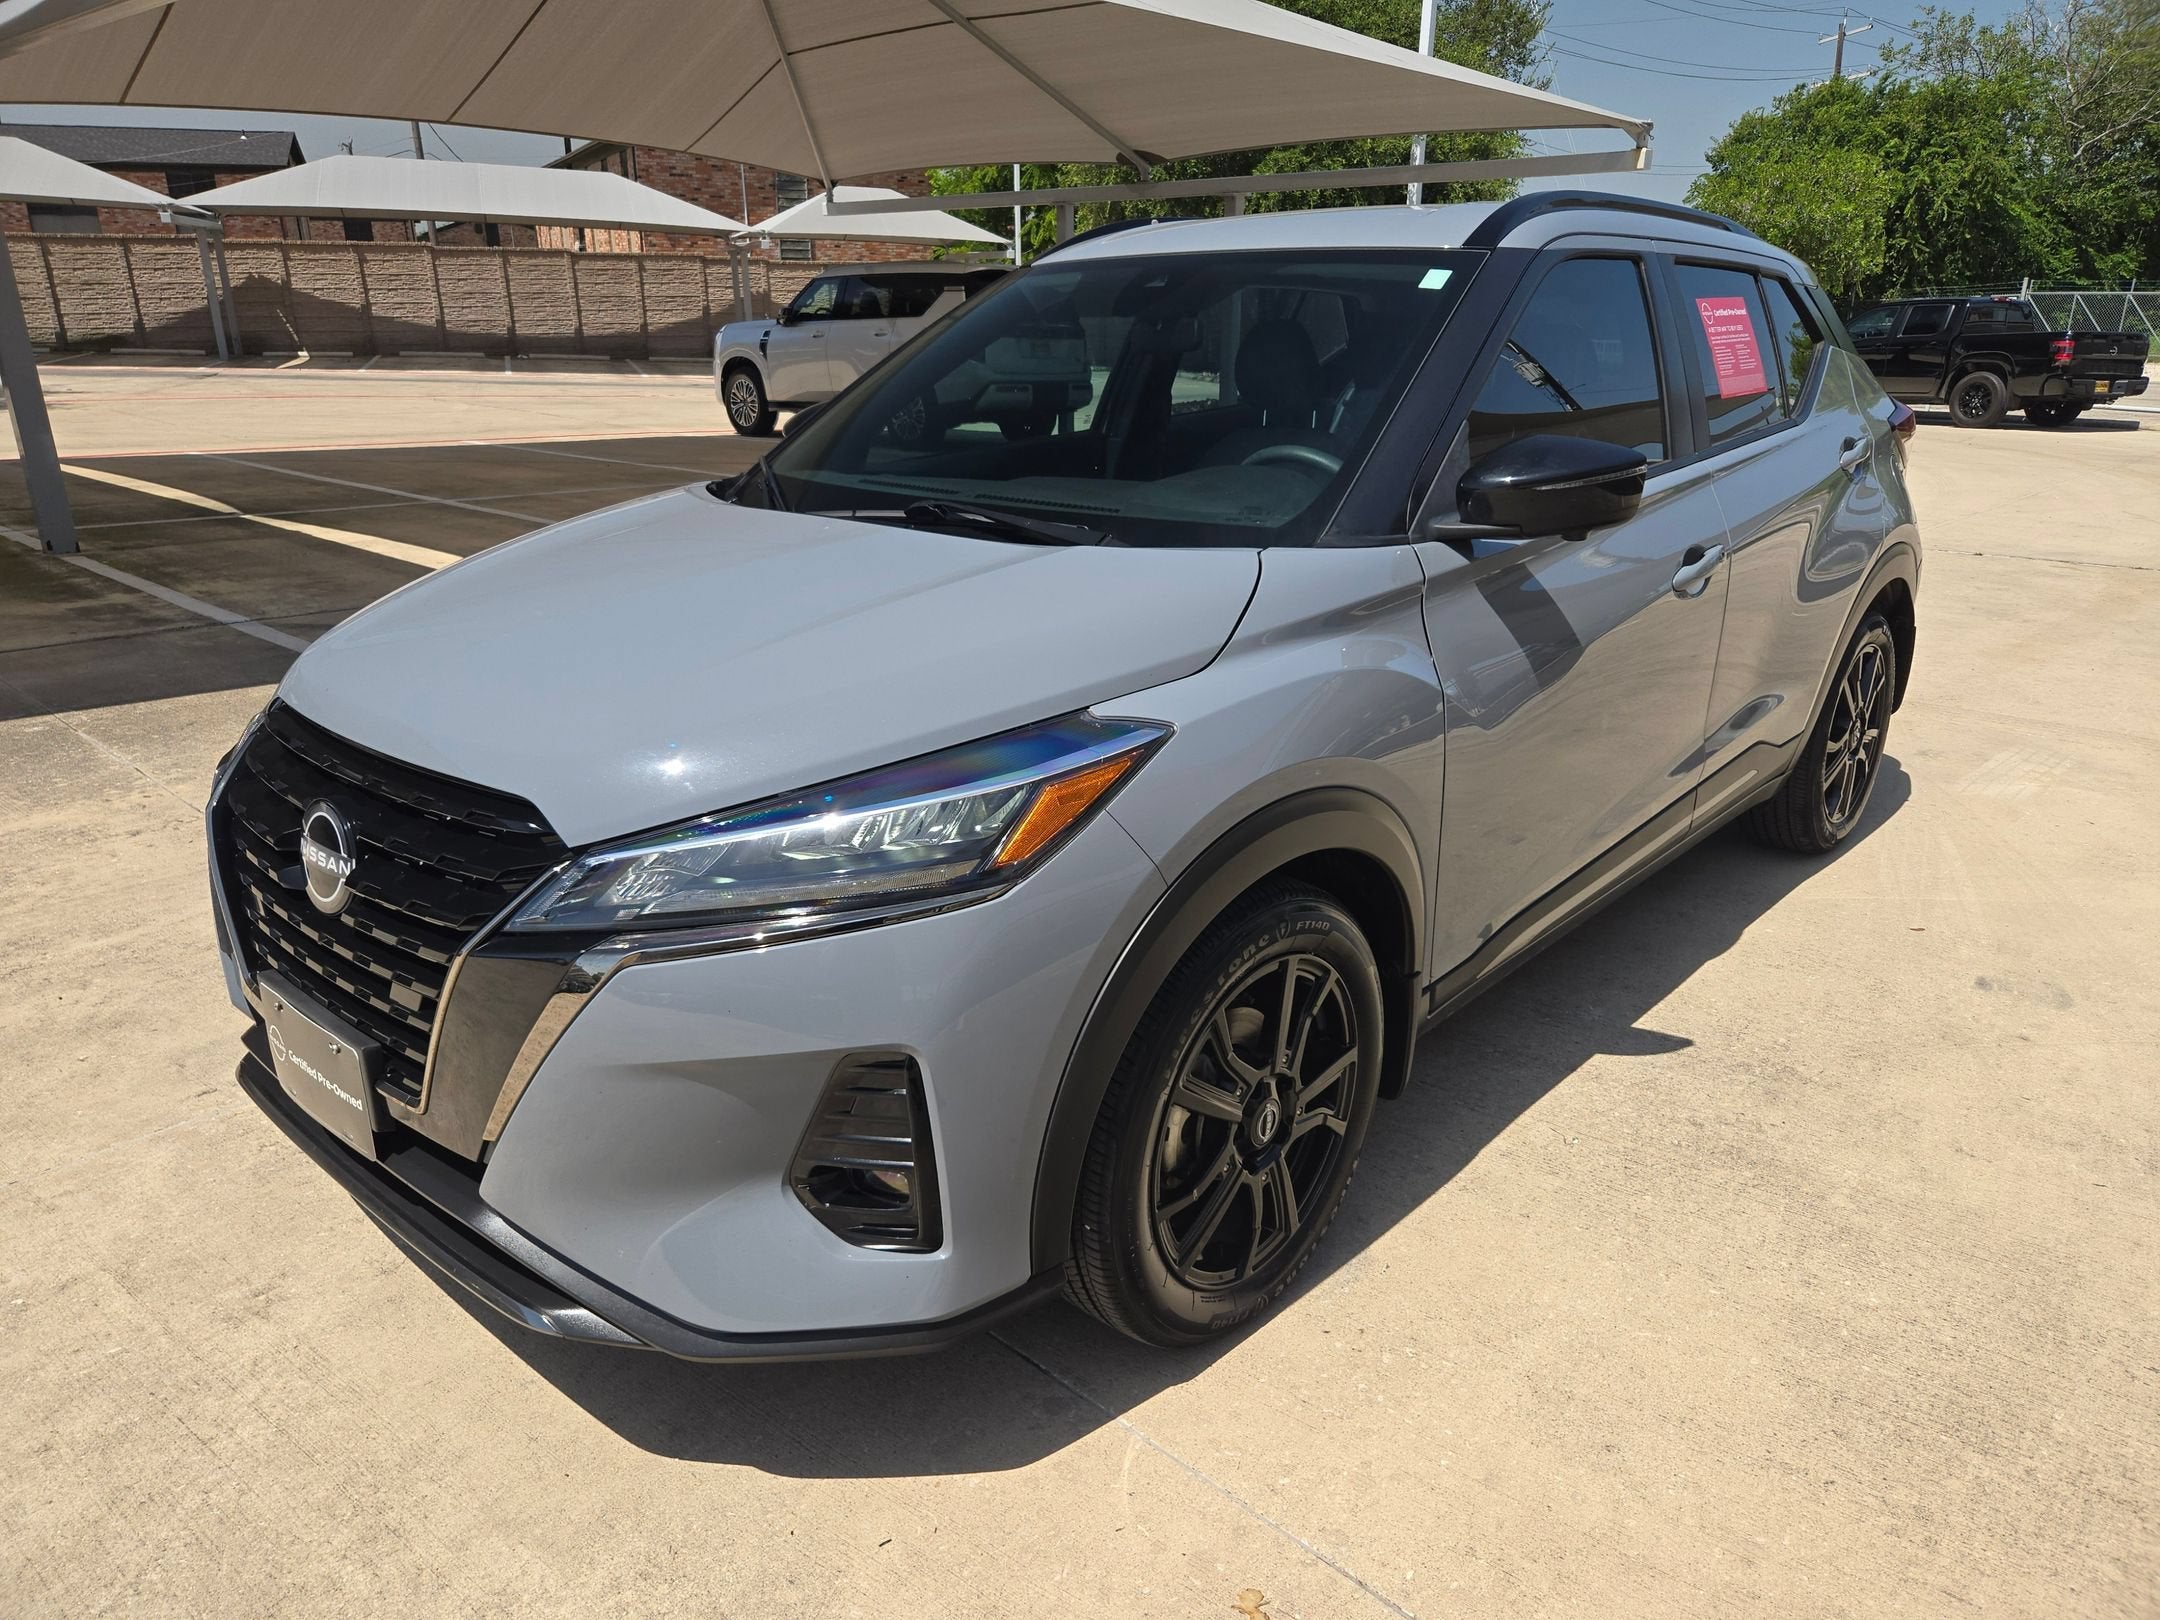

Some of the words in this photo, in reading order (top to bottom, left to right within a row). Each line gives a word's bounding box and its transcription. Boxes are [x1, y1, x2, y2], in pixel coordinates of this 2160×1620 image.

[300, 836, 351, 877] NISSAN
[288, 1049, 318, 1081] Certified
[317, 1071, 364, 1112] Pre-Owned
